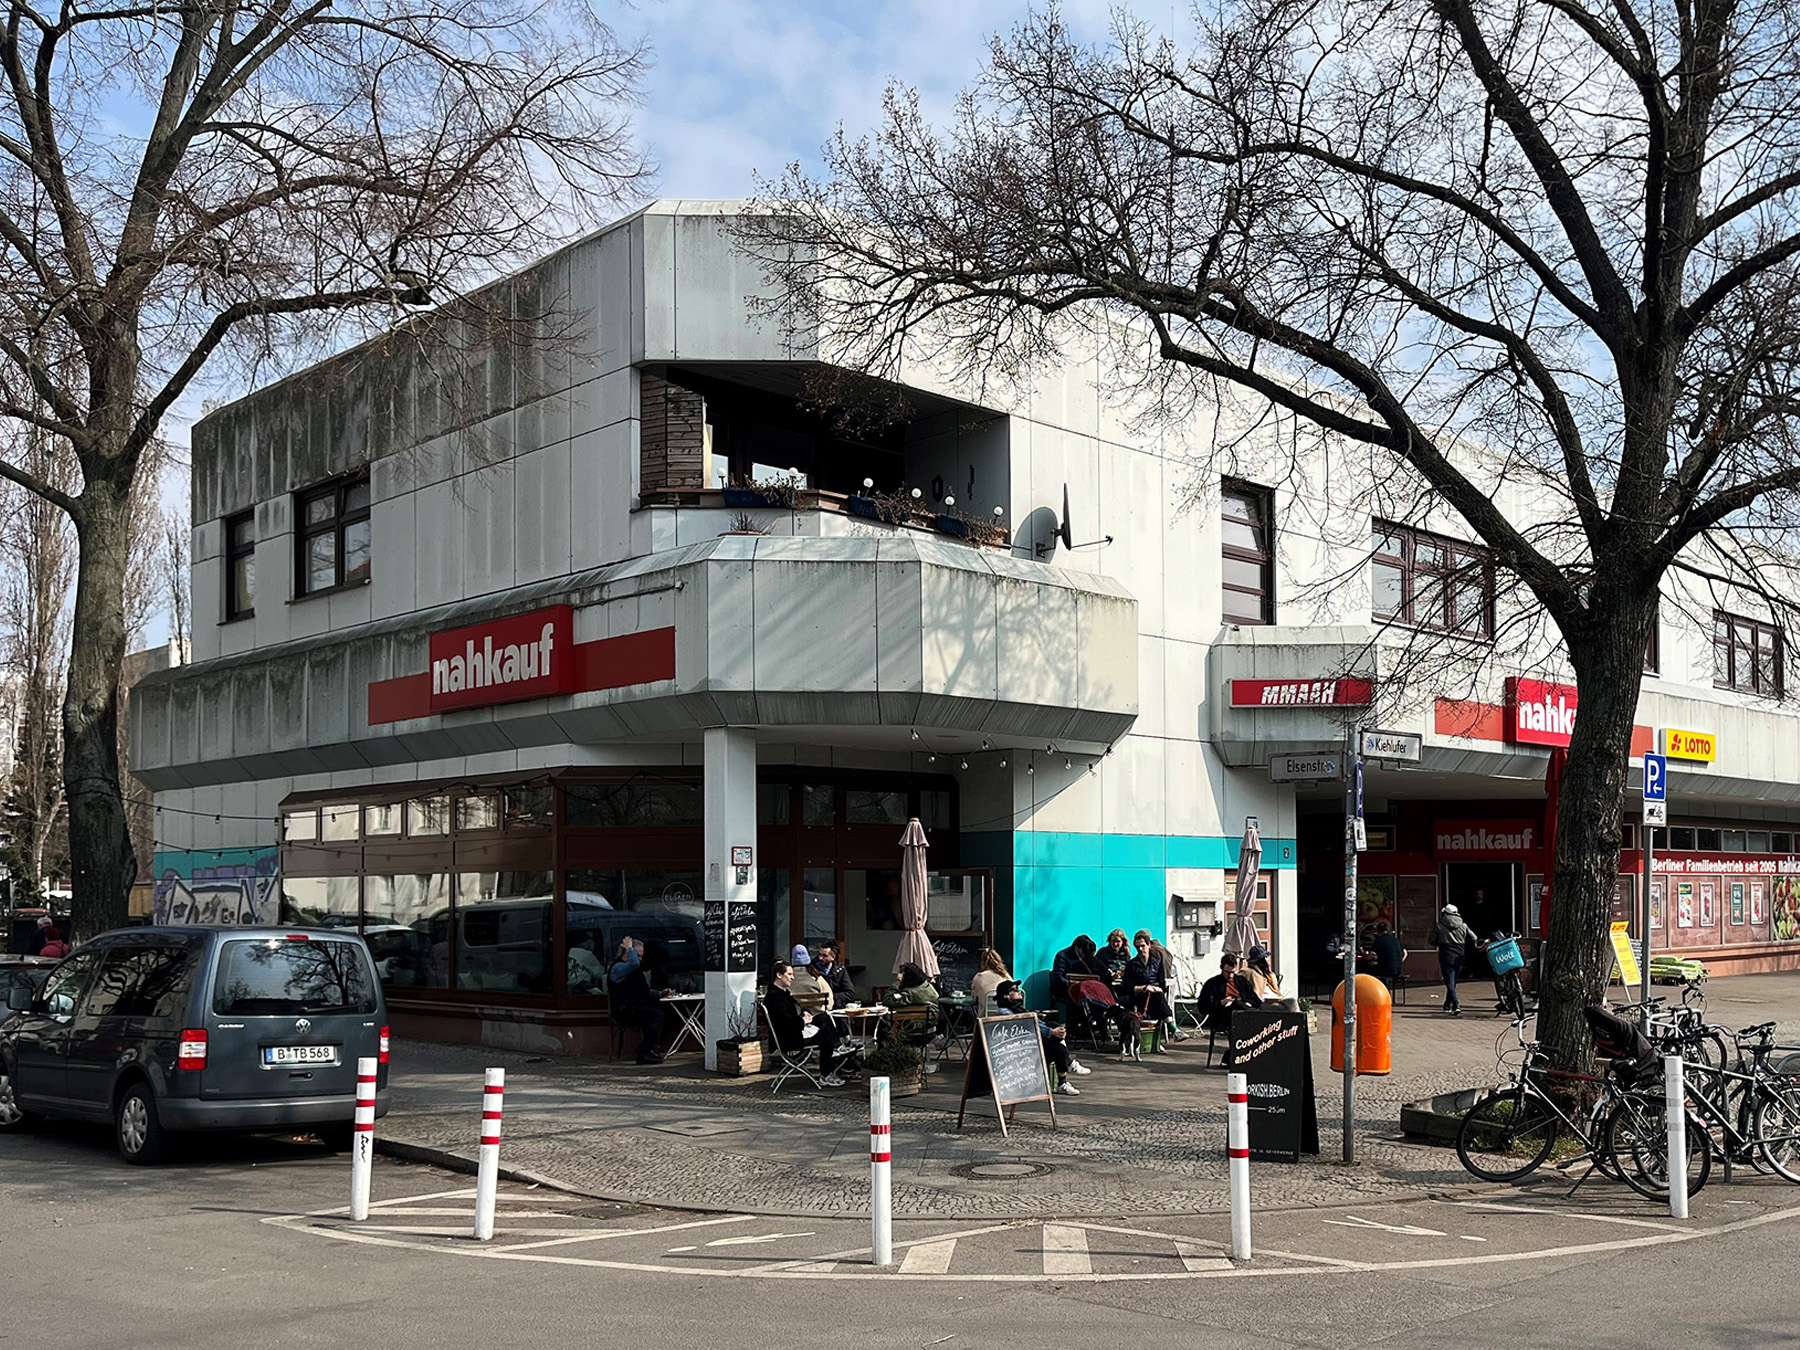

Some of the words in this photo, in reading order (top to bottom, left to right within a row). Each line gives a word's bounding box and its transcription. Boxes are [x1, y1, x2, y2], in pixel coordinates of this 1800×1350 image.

[432, 622, 554, 695] nahkauf
[1375, 738, 1407, 753] Kiehlufer
[1685, 736, 1711, 755] LOTTO
[1647, 759, 1661, 793] P
[1437, 828, 1533, 850] nahkauf
[1652, 859, 1684, 872] Berliner
[1686, 859, 1743, 872] Familienbetrieb
[1745, 861, 1758, 872] seit
[1760, 861, 1776, 872] 2005
[1495, 951, 1515, 964] Wolt
[1235, 1018, 1283, 1050] Coworking
[278, 1049, 285, 1059] B
[309, 1047, 330, 1058] 568
[1234, 1050, 1251, 1064] and
[1252, 1036, 1276, 1058] other
[1276, 1025, 1299, 1042] stuff
[1247, 1083, 1290, 1098] ORKISH.BERLIN
